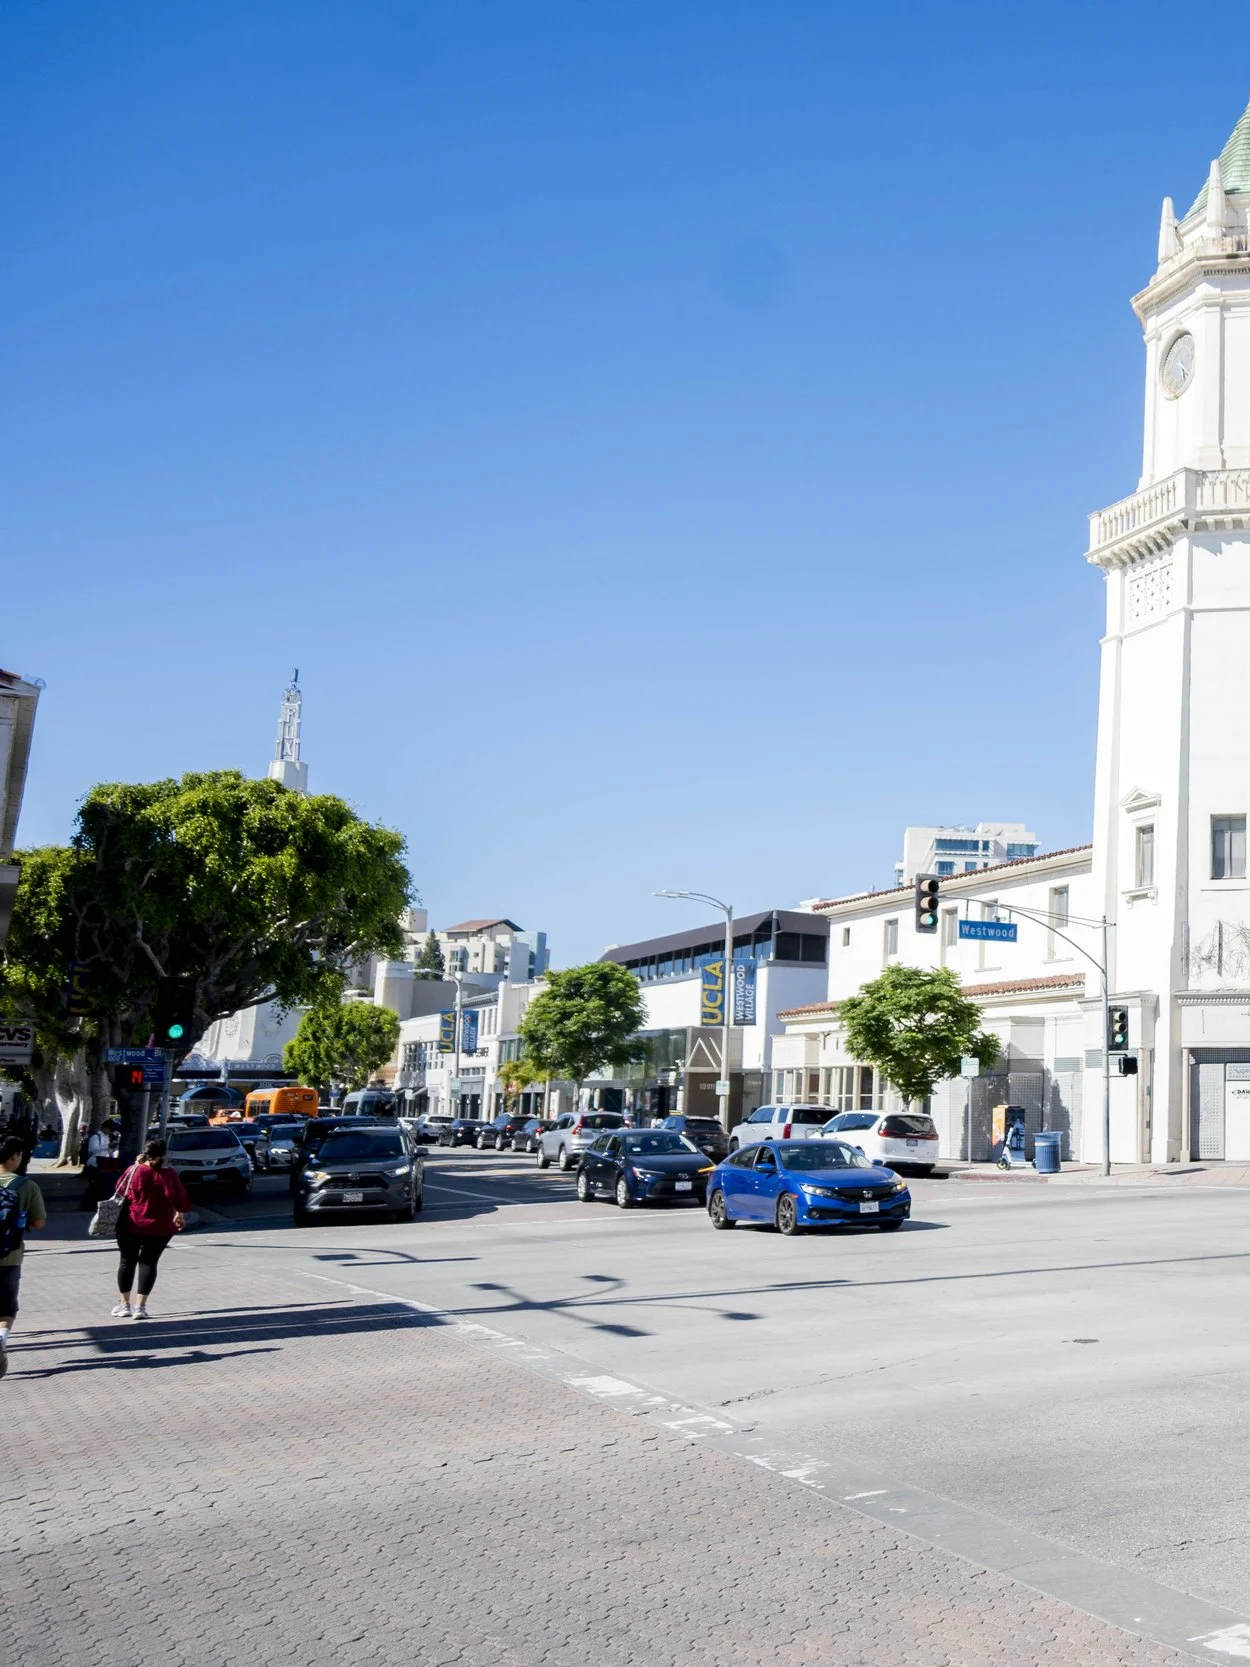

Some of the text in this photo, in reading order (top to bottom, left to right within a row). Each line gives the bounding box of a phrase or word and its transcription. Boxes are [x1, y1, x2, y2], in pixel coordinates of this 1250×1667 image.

[961, 924, 1015, 938] Westwood
[702, 961, 723, 1025] UCLA
[735, 964, 746, 1020] WESTWOOD
[744, 983, 755, 1020] VILLAGE
[440, 1012, 454, 1052] UCLA
[107, 1048, 146, 1057] Westwood
[131, 1071, 142, 1084] 14
